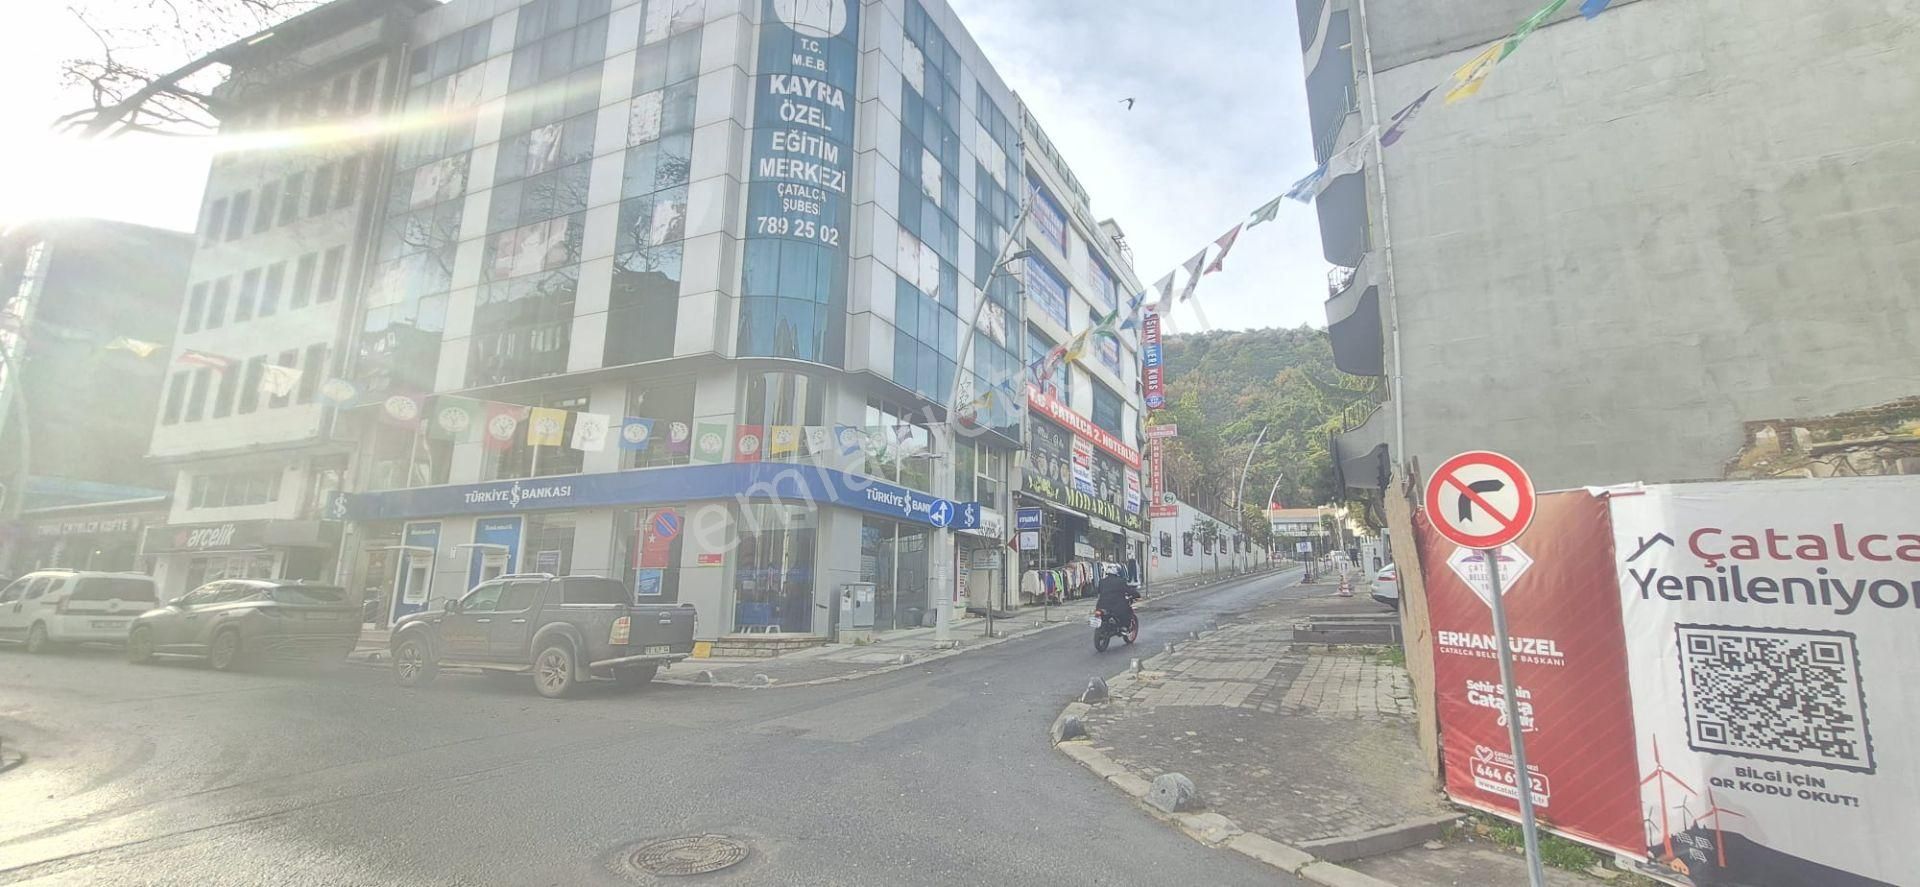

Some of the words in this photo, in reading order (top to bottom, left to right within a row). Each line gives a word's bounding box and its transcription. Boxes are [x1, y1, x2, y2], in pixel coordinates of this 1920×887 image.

[801, 38, 822, 54] T.C.
[792, 53, 828, 73] M.E.B.
[770, 74, 845, 112] KAYRA
[780, 99, 832, 131] ÖZEL
[772, 130, 838, 164] EĞİTİM
[760, 158, 846, 193] MERKEZİ
[757, 217, 788, 235] 789
[794, 222, 815, 239] 25
[820, 227, 838, 246] 02
[1051, 401, 1092, 438] ÇATALCA
[464, 488, 509, 503] TÜRKİYE
[521, 485, 571, 500] BANKASI
[866, 487, 904, 507] TÜRKİYE
[1019, 513, 1038, 523] mavi
[1688, 523, 1920, 567] Çatalca
[1438, 631, 1497, 650] ERHAN
[1509, 637, 1564, 658] ÜZEL
[1521, 655, 1565, 666] BAŞKANI
[1477, 764, 1502, 780] 444
[1735, 766, 1780, 783] BİLGİ
[1787, 772, 1826, 788] İÇİN
[1709, 776, 1735, 788] QR
[1739, 781, 1792, 798] KODU
[1797, 789, 1860, 807] OKUT!
